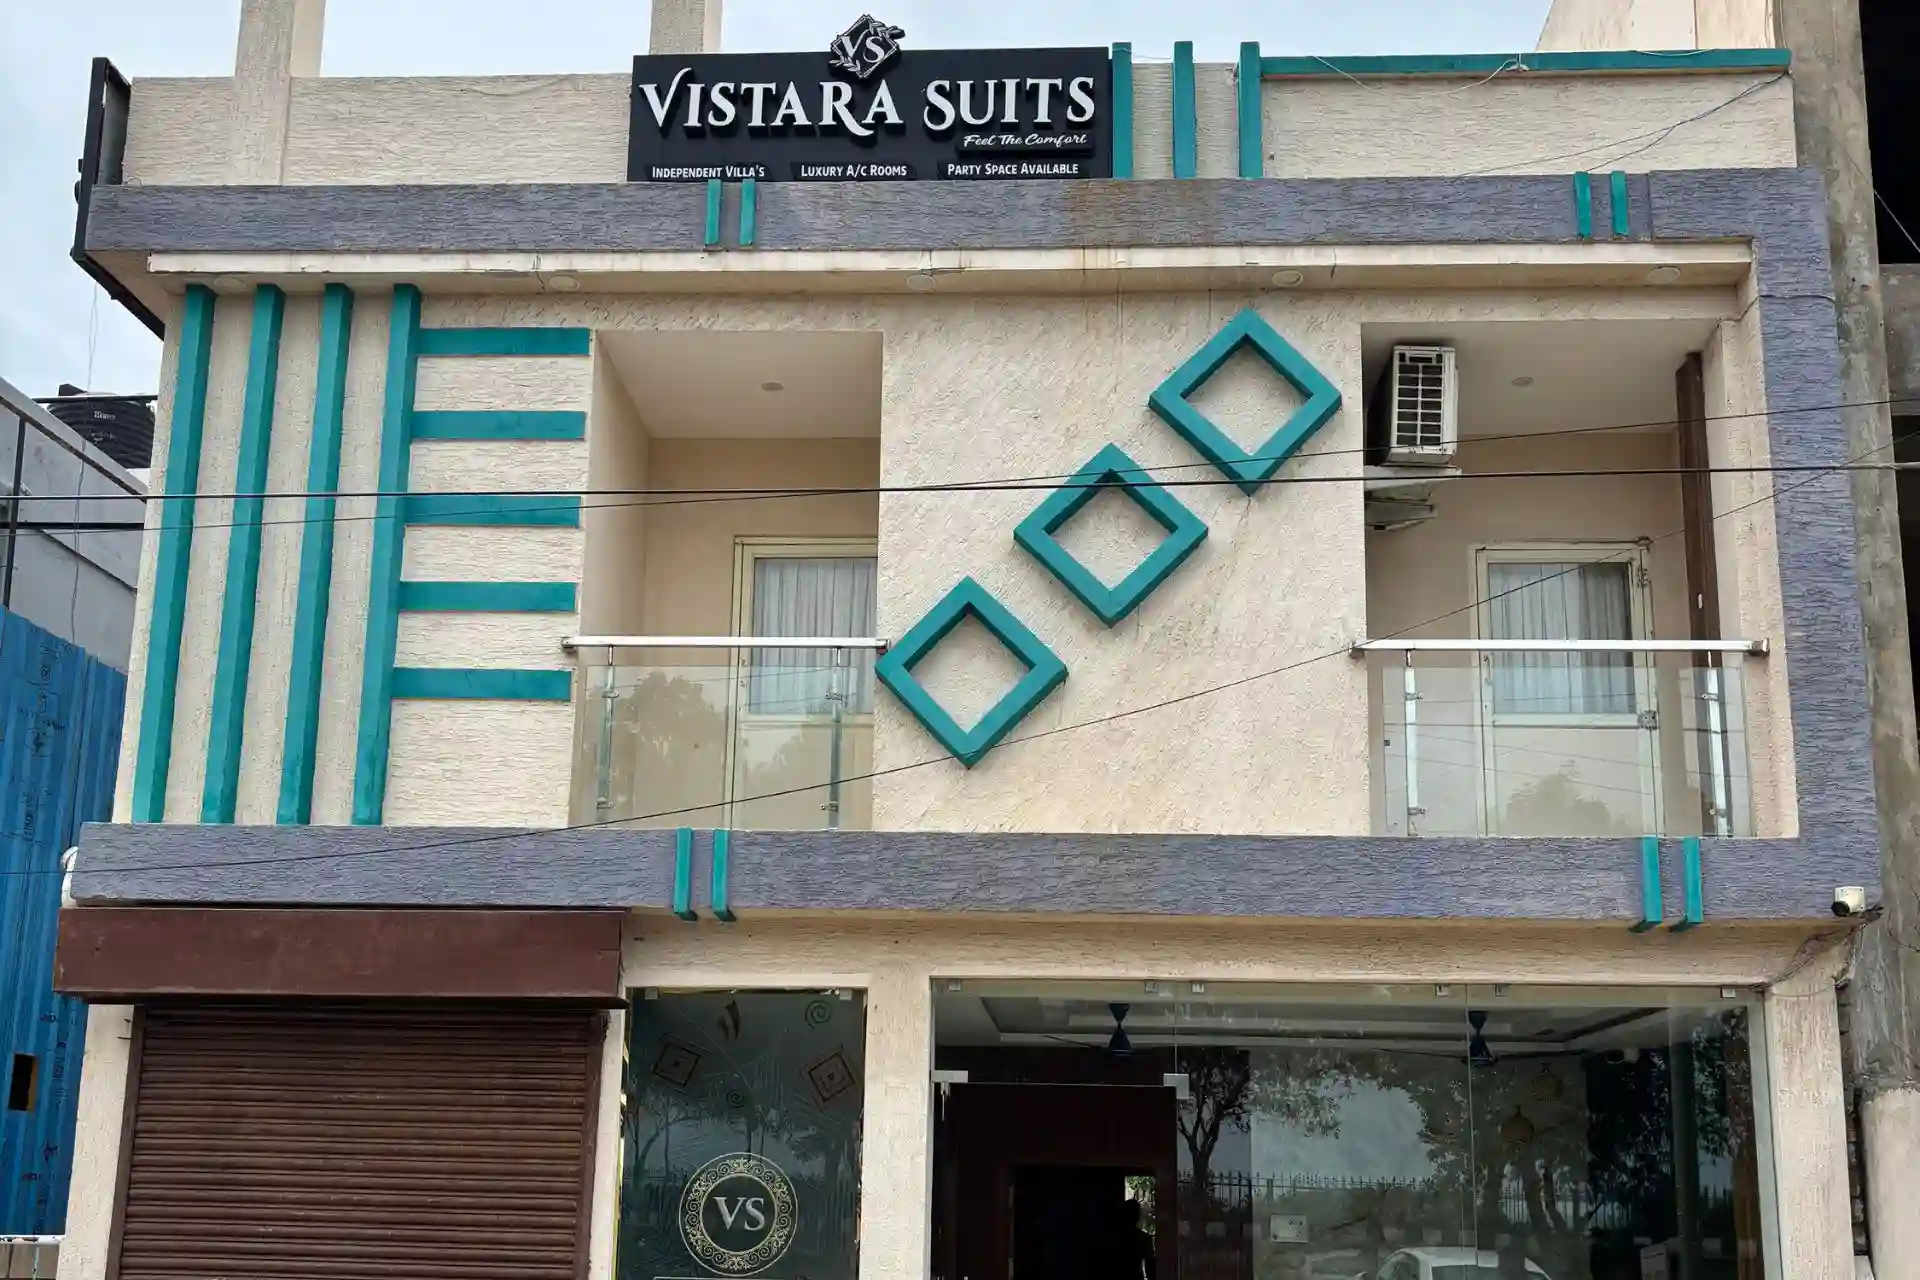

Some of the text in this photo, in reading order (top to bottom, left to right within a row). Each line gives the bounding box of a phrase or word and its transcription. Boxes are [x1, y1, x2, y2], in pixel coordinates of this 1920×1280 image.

[841, 28, 885, 63] VS
[638, 67, 1095, 136] VISTARA SUITS
[963, 133, 1088, 148] Feel The Comfort
[652, 165, 765, 178] INDEPENDENT VILLA'S
[801, 165, 843, 177] LUXURY
[870, 164, 908, 176] ROOMS
[948, 162, 1079, 176] PARTY SPACE AVAILABLE
[713, 1196, 765, 1231] VS
